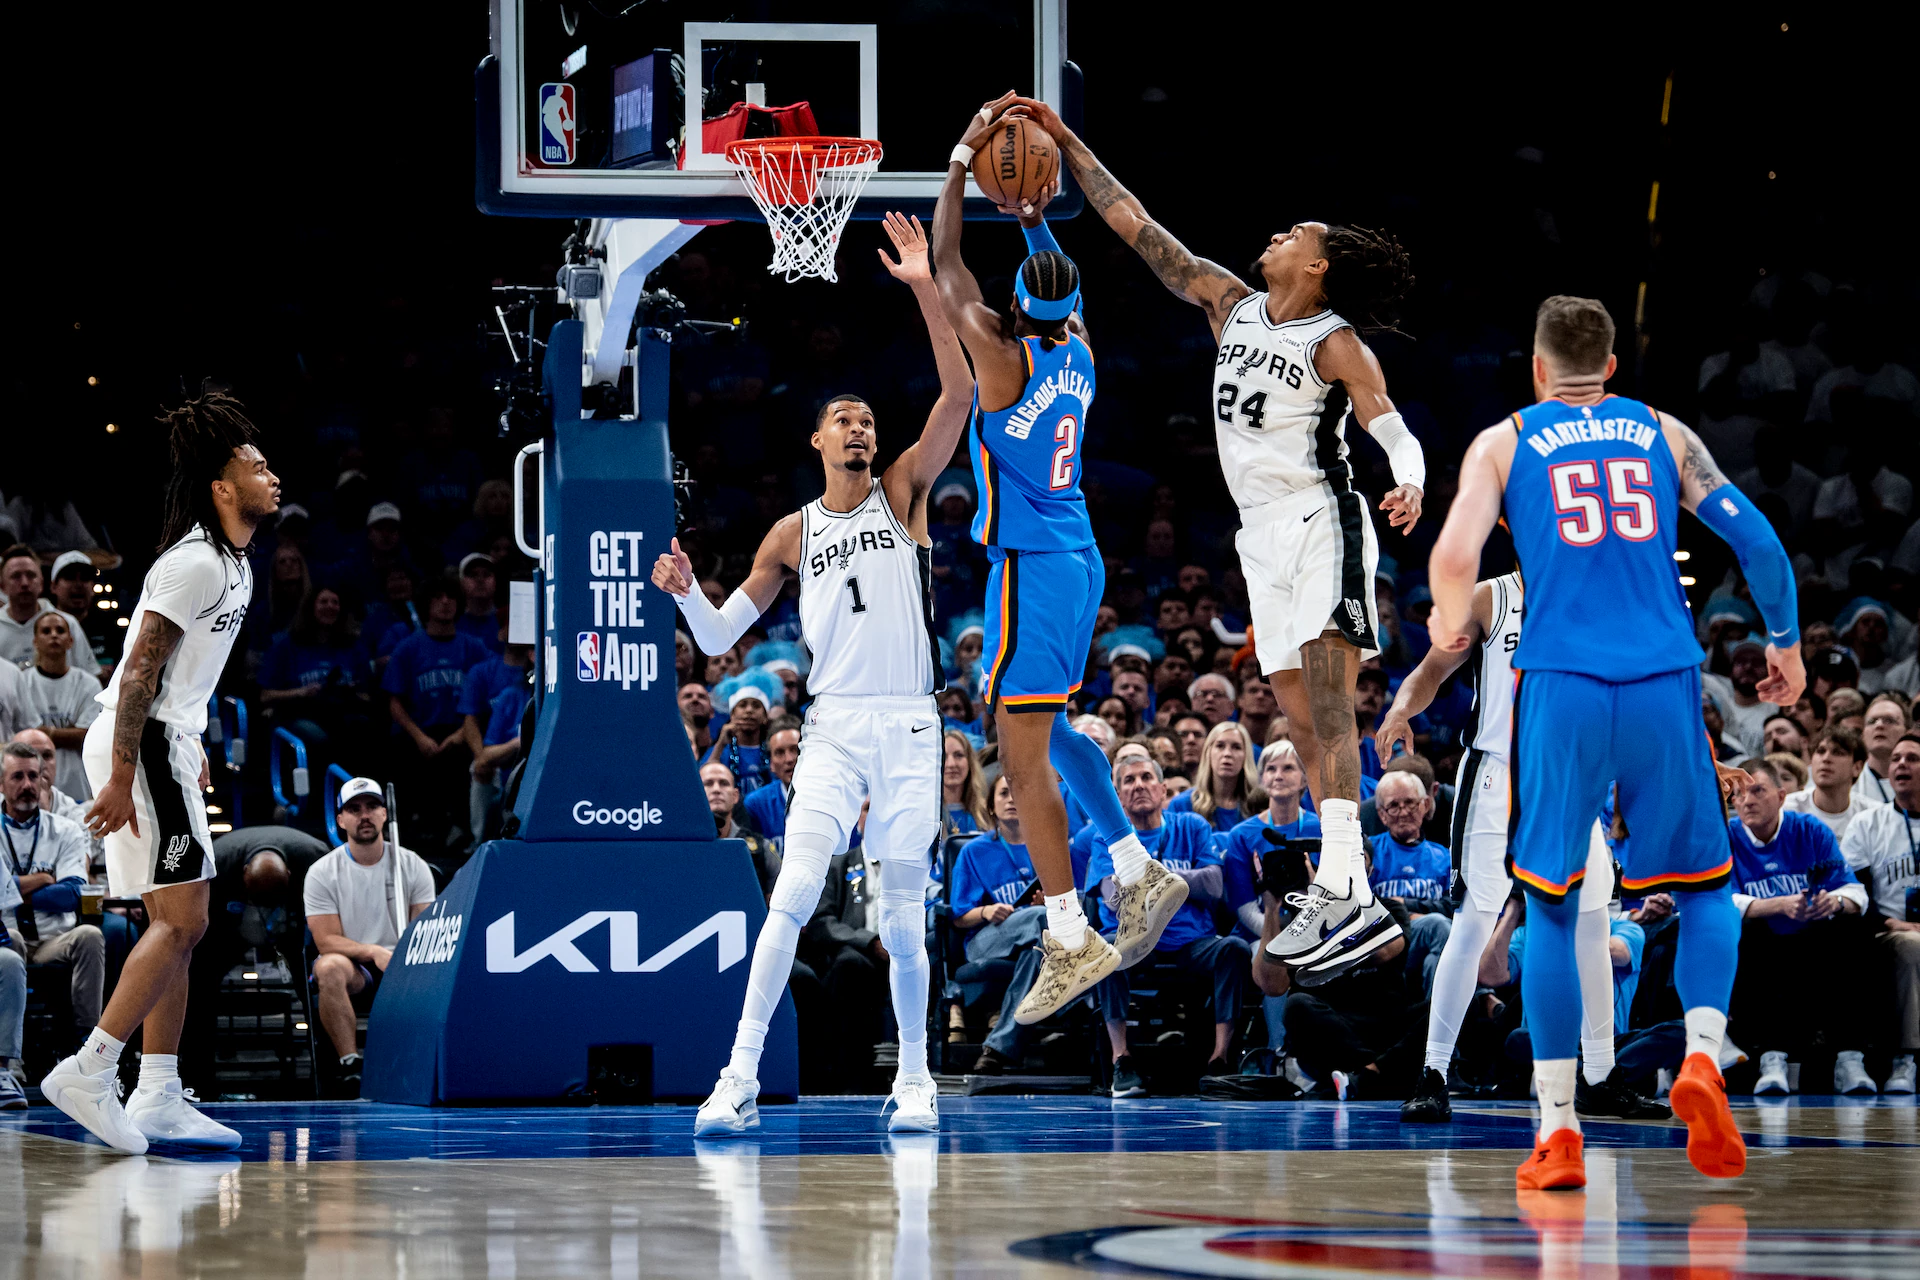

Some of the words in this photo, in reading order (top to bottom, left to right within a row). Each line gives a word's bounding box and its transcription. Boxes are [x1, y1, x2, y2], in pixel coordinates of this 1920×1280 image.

[545, 146, 563, 159] NBA
[1000, 124, 1017, 181] Wilson
[1217, 344, 1304, 391] SPURS
[1217, 381, 1271, 432] 24
[1050, 414, 1079, 491] 2
[1527, 418, 1658, 458] HARTENSTEIN
[1548, 457, 1659, 547] 55
[589, 530, 643, 577] GET
[811, 529, 896, 578] SPURS
[589, 581, 645, 628] THE
[845, 575, 869, 615] 1
[603, 632, 658, 691] App
[572, 800, 663, 831] Google
[1744, 873, 1809, 899] THUNDE
[404, 900, 463, 966] coinbase
